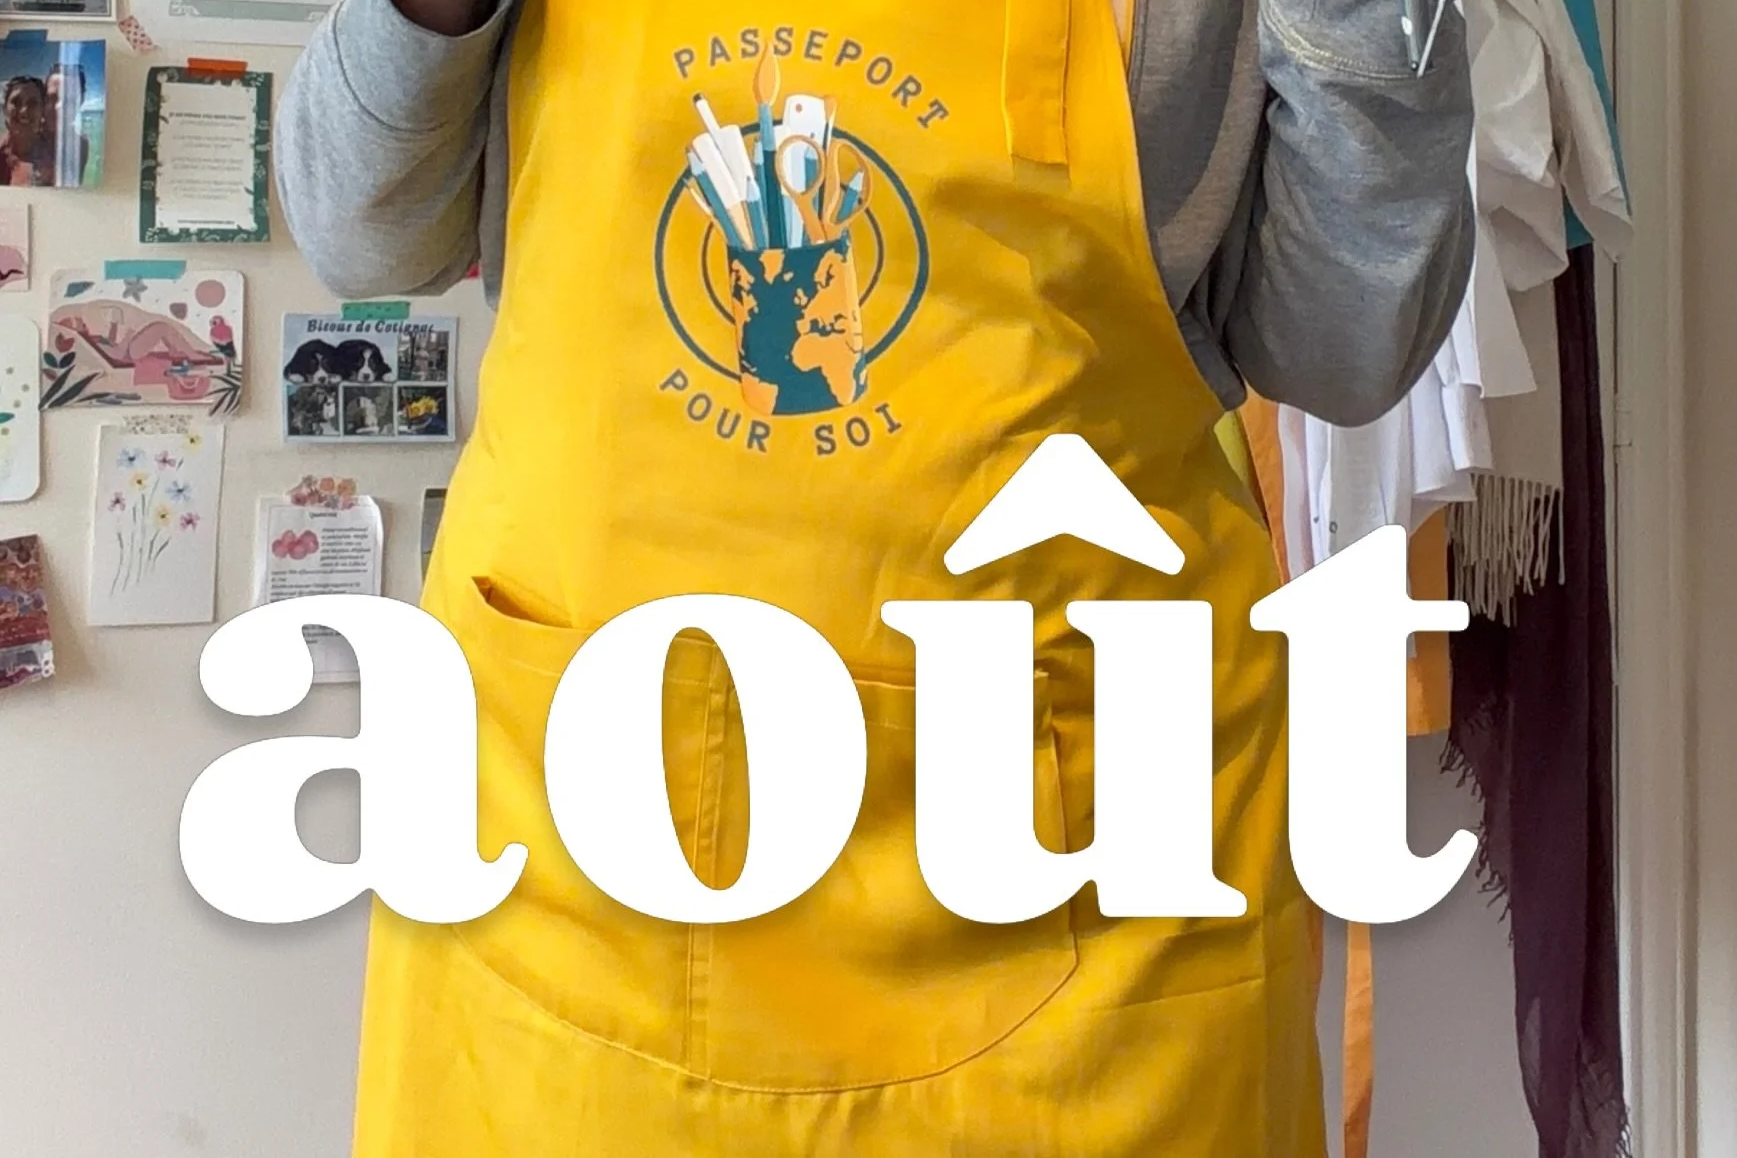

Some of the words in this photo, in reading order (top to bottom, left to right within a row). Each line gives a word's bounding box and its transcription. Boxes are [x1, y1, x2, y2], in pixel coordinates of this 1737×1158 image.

[673, 26, 950, 132] PASSEPORT
[355, 320, 371, 332] de
[659, 369, 773, 453] POUR
[815, 401, 903, 457] SOI
